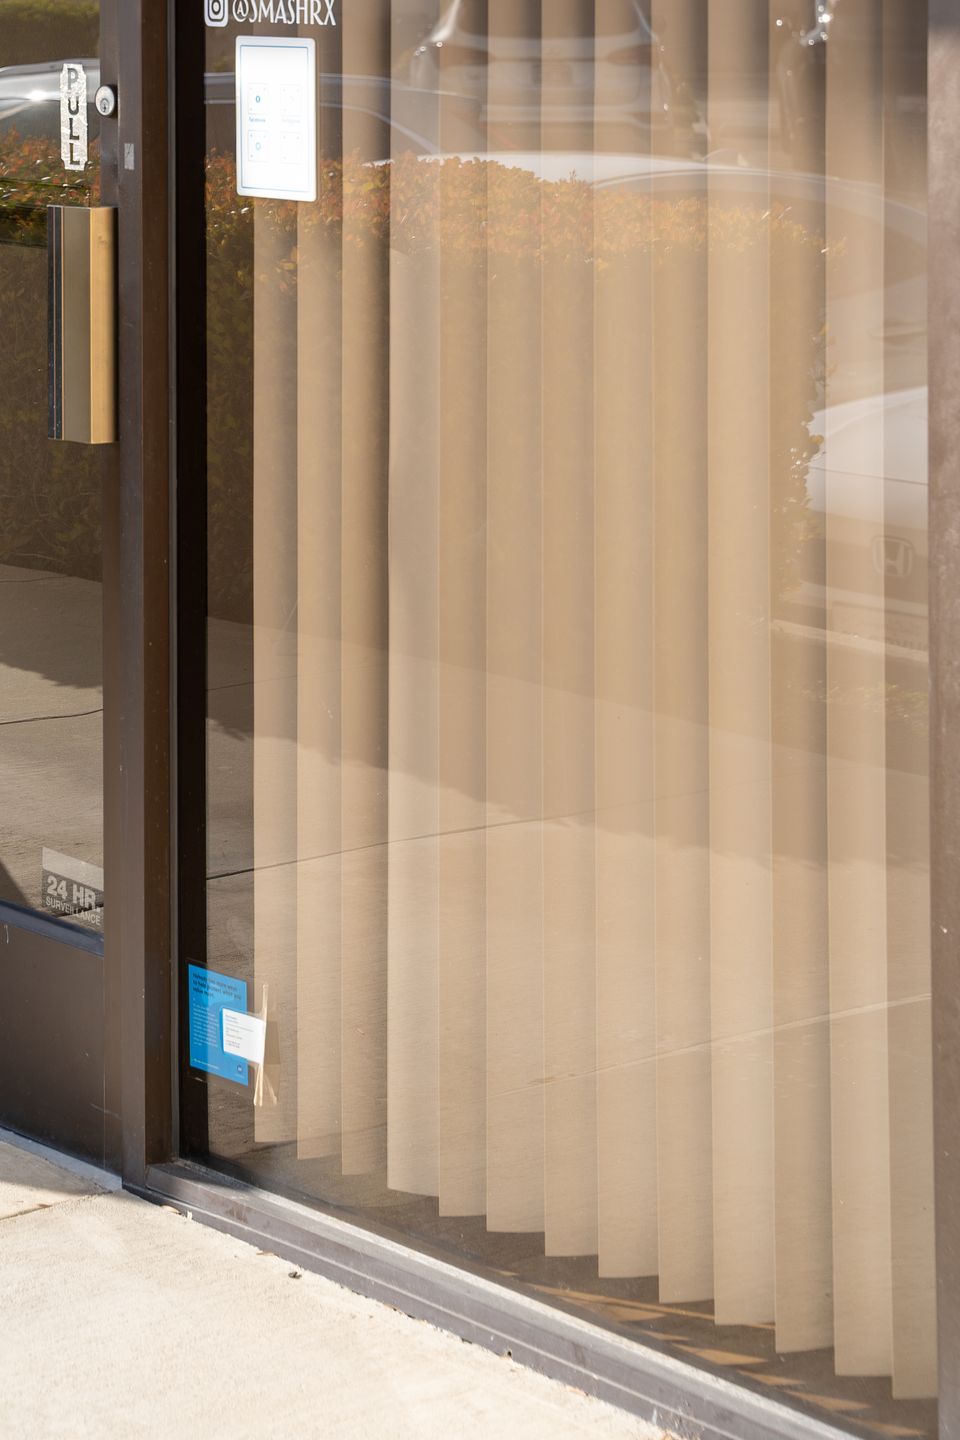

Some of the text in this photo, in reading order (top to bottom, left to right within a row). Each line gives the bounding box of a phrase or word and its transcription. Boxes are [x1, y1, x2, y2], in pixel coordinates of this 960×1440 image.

[67, 67, 81, 166] PULL
[46, 875, 68, 900] 24
[45, 895, 101, 926] SURVEILLANCE
